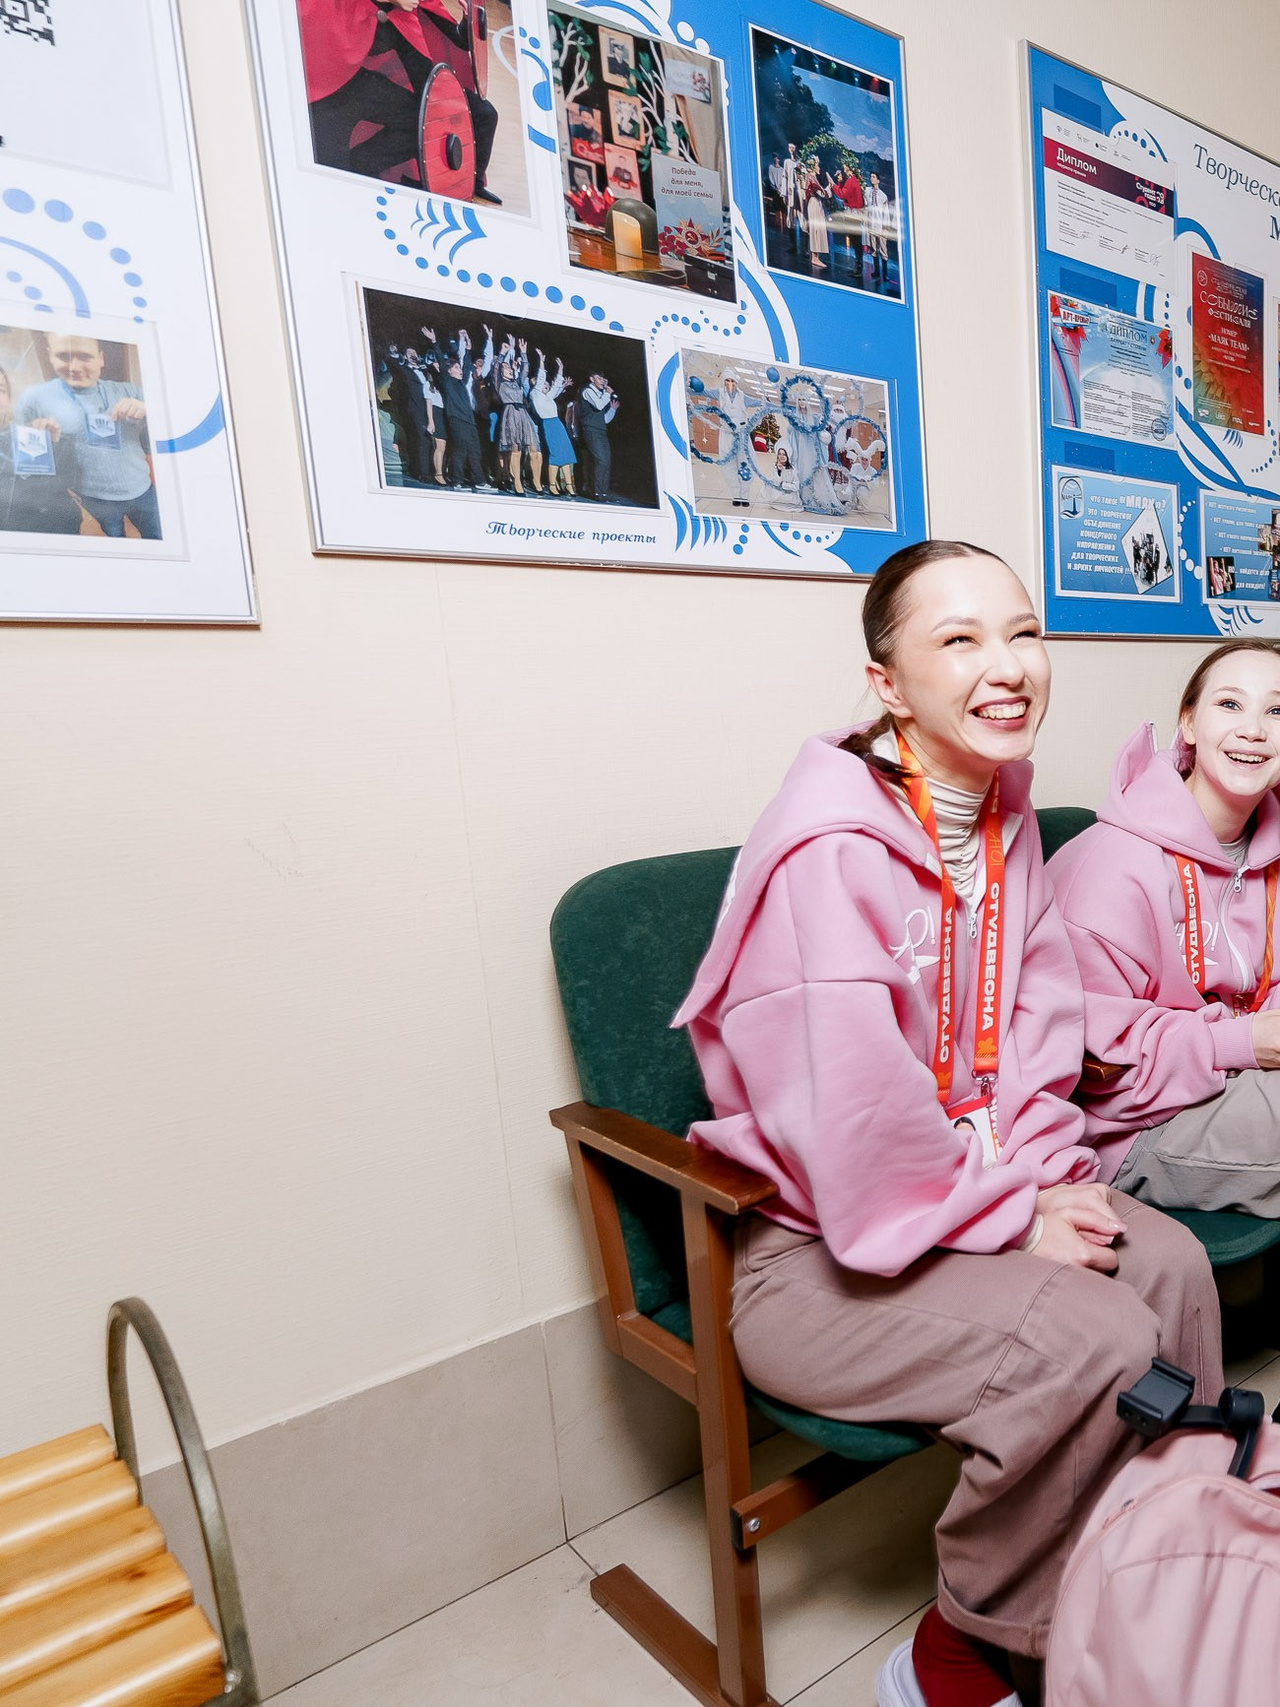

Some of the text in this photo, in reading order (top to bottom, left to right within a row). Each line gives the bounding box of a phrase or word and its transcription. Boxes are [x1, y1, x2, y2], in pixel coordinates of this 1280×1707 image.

[1056, 148, 1098, 175] Диплом
[671, 166, 697, 176] Победа
[671, 177, 703, 188] для меня,
[661, 187, 714, 200] для моей семьи
[1109, 325, 1148, 344] ДИПЛОМ
[1090, 495, 1100, 503] ЧТО
[1101, 496, 1118, 506] ТАКОЕ
[1088, 507, 1133, 520] ЭТО ТВОРЧЕСКОЕ
[1083, 518, 1122, 530] ОБЪЕДИНЕНИЕ
[486, 521, 656, 545] Творческие проекты
[1079, 529, 1118, 542] КОНЦЕРТНОГО
[1076, 541, 1116, 552] НАПРАВЛЕНИЯ
[1071, 551, 1119, 563] ДЛЯ ТВОРЧЕСКИХ
[1072, 562, 1093, 572] ЯРКИХ
[1094, 563, 1124, 575] ЛИЧНОСТЕЙ
